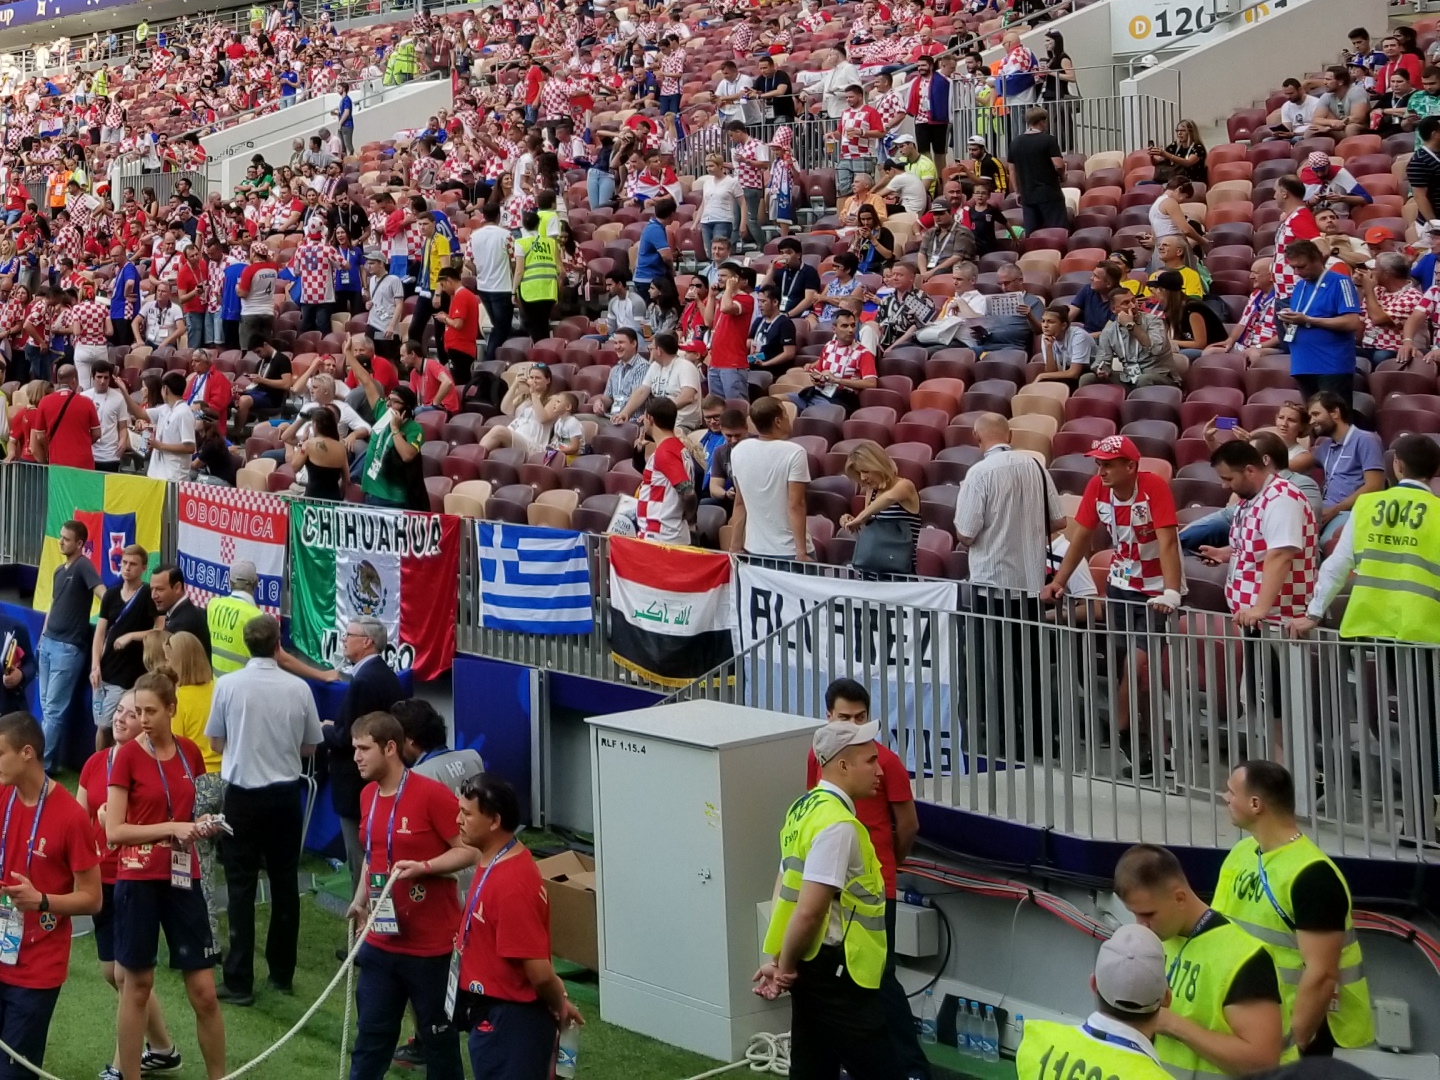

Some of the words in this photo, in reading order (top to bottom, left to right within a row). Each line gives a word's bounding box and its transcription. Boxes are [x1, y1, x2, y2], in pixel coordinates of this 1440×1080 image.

[264, 281, 271, 295] 4
[186, 499, 274, 539] OBODNICA
[1371, 499, 1427, 529] 3043
[301, 506, 442, 558] CHIHUAHUA
[601, 737, 617, 748] RLF
[620, 741, 646, 754] 1.15.4
